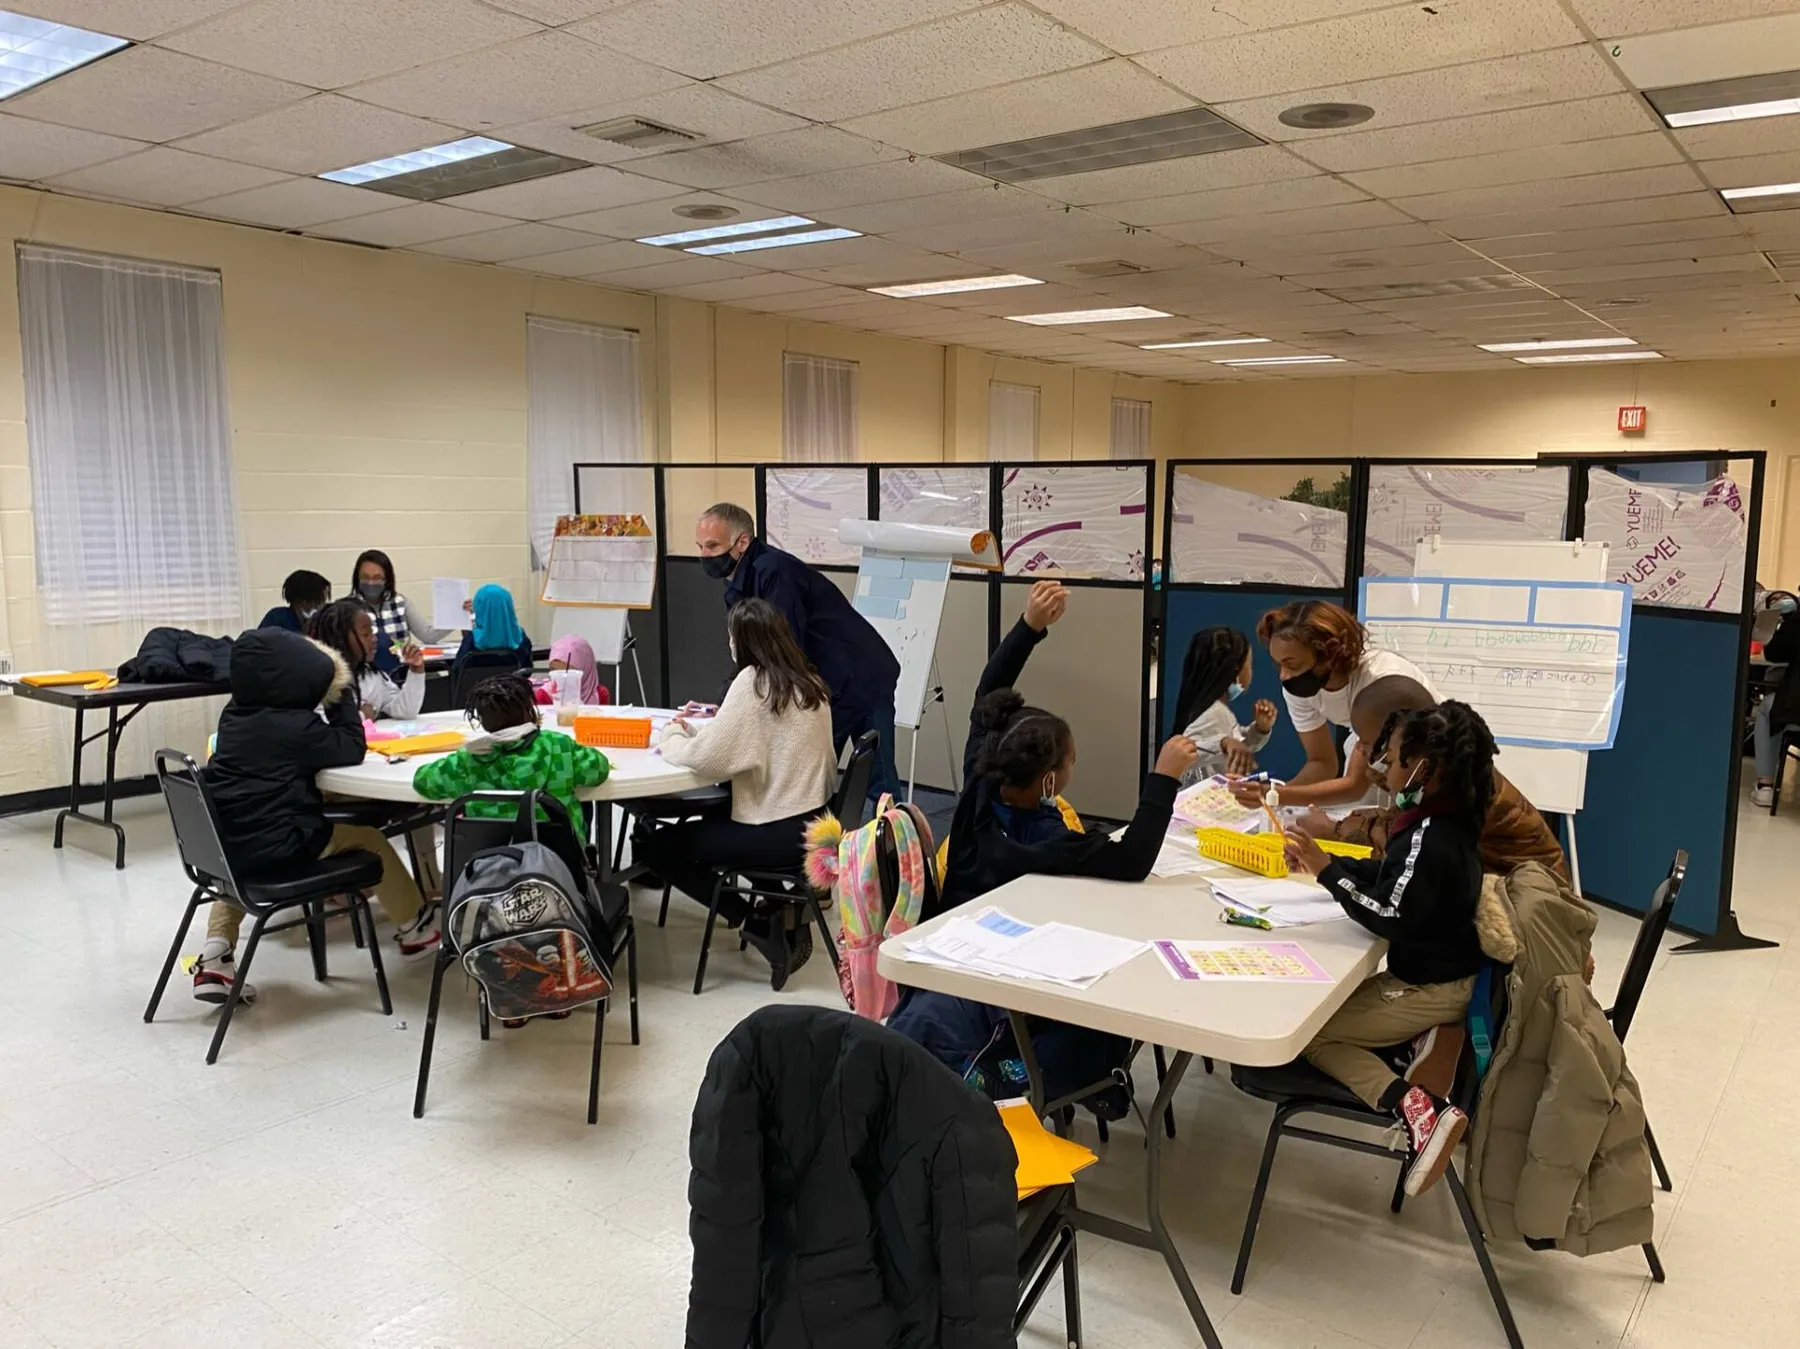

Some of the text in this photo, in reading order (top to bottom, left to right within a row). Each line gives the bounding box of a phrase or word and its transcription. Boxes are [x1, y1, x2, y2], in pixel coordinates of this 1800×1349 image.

[1622, 409, 1642, 428] EXIT
[1616, 535, 1682, 586] YUEMEI
[504, 888, 543, 911] STAR
[504, 897, 547, 923] WARS
